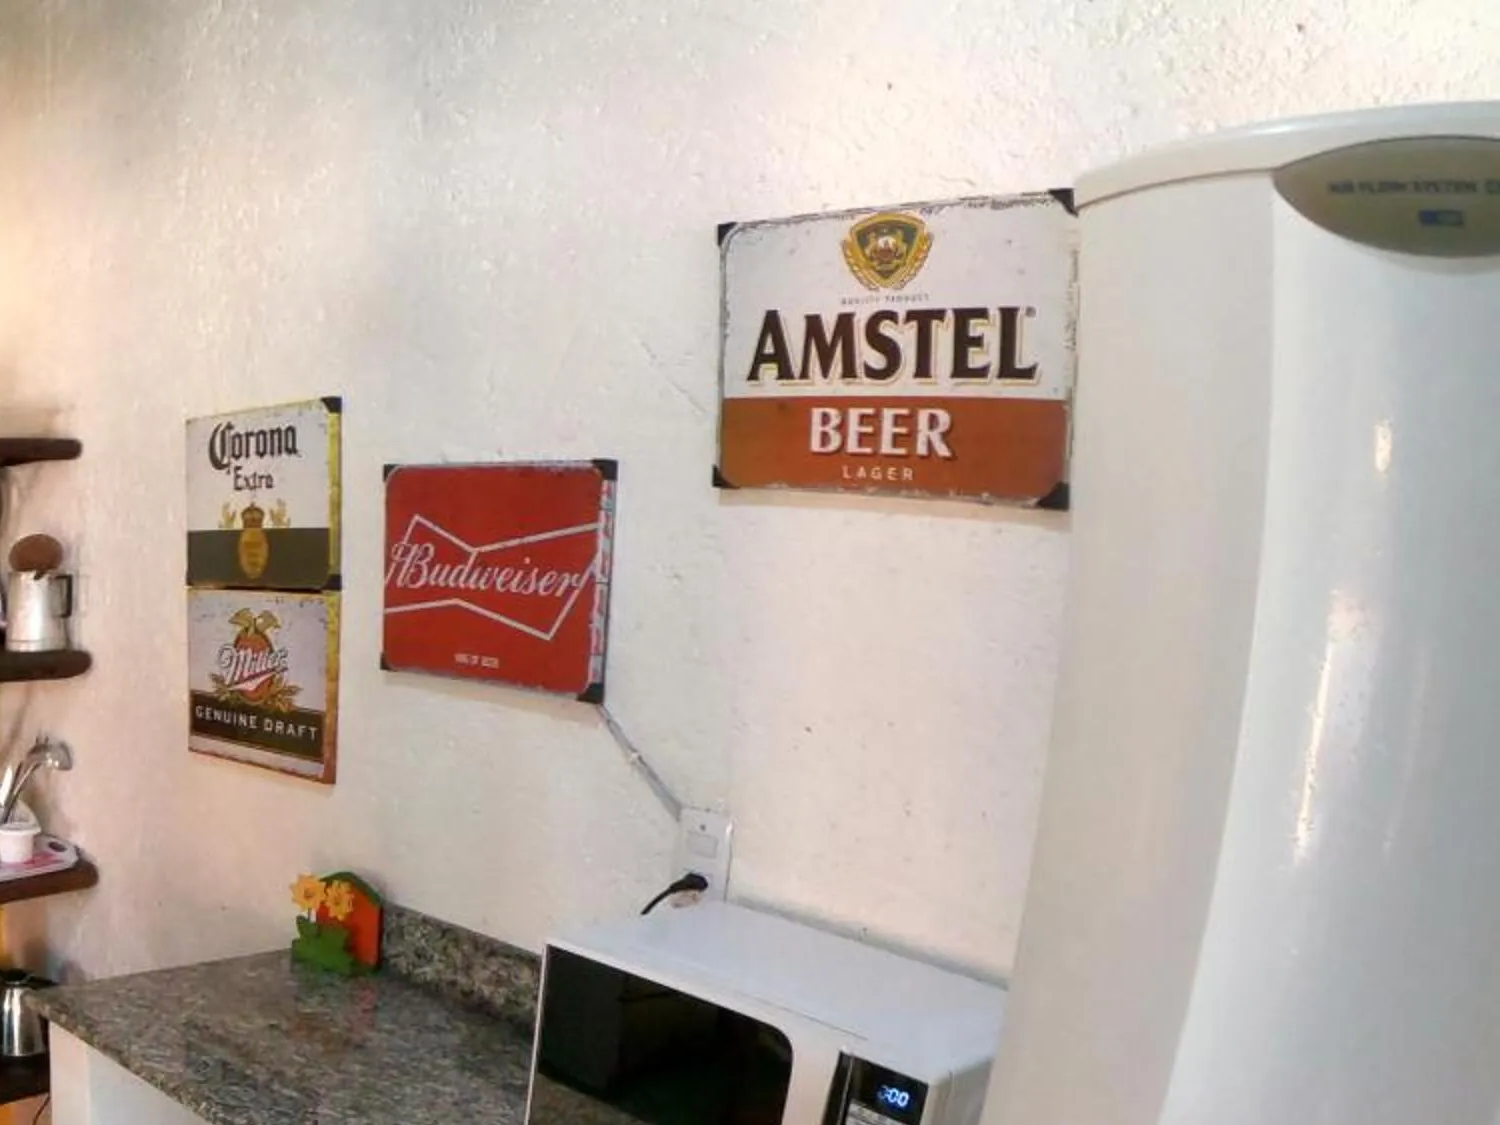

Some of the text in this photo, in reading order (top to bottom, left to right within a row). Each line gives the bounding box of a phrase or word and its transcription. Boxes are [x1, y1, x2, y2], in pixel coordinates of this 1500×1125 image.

[746, 305, 1040, 384] AMSTEL
[208, 420, 300, 475] Corona
[809, 406, 954, 459] BEER
[232, 465, 274, 491] Extra
[842, 465, 914, 482] LAGER
[390, 542, 581, 598] Budweiser
[217, 643, 289, 686] Miller
[195, 705, 319, 741] GENUINE DRAFT
